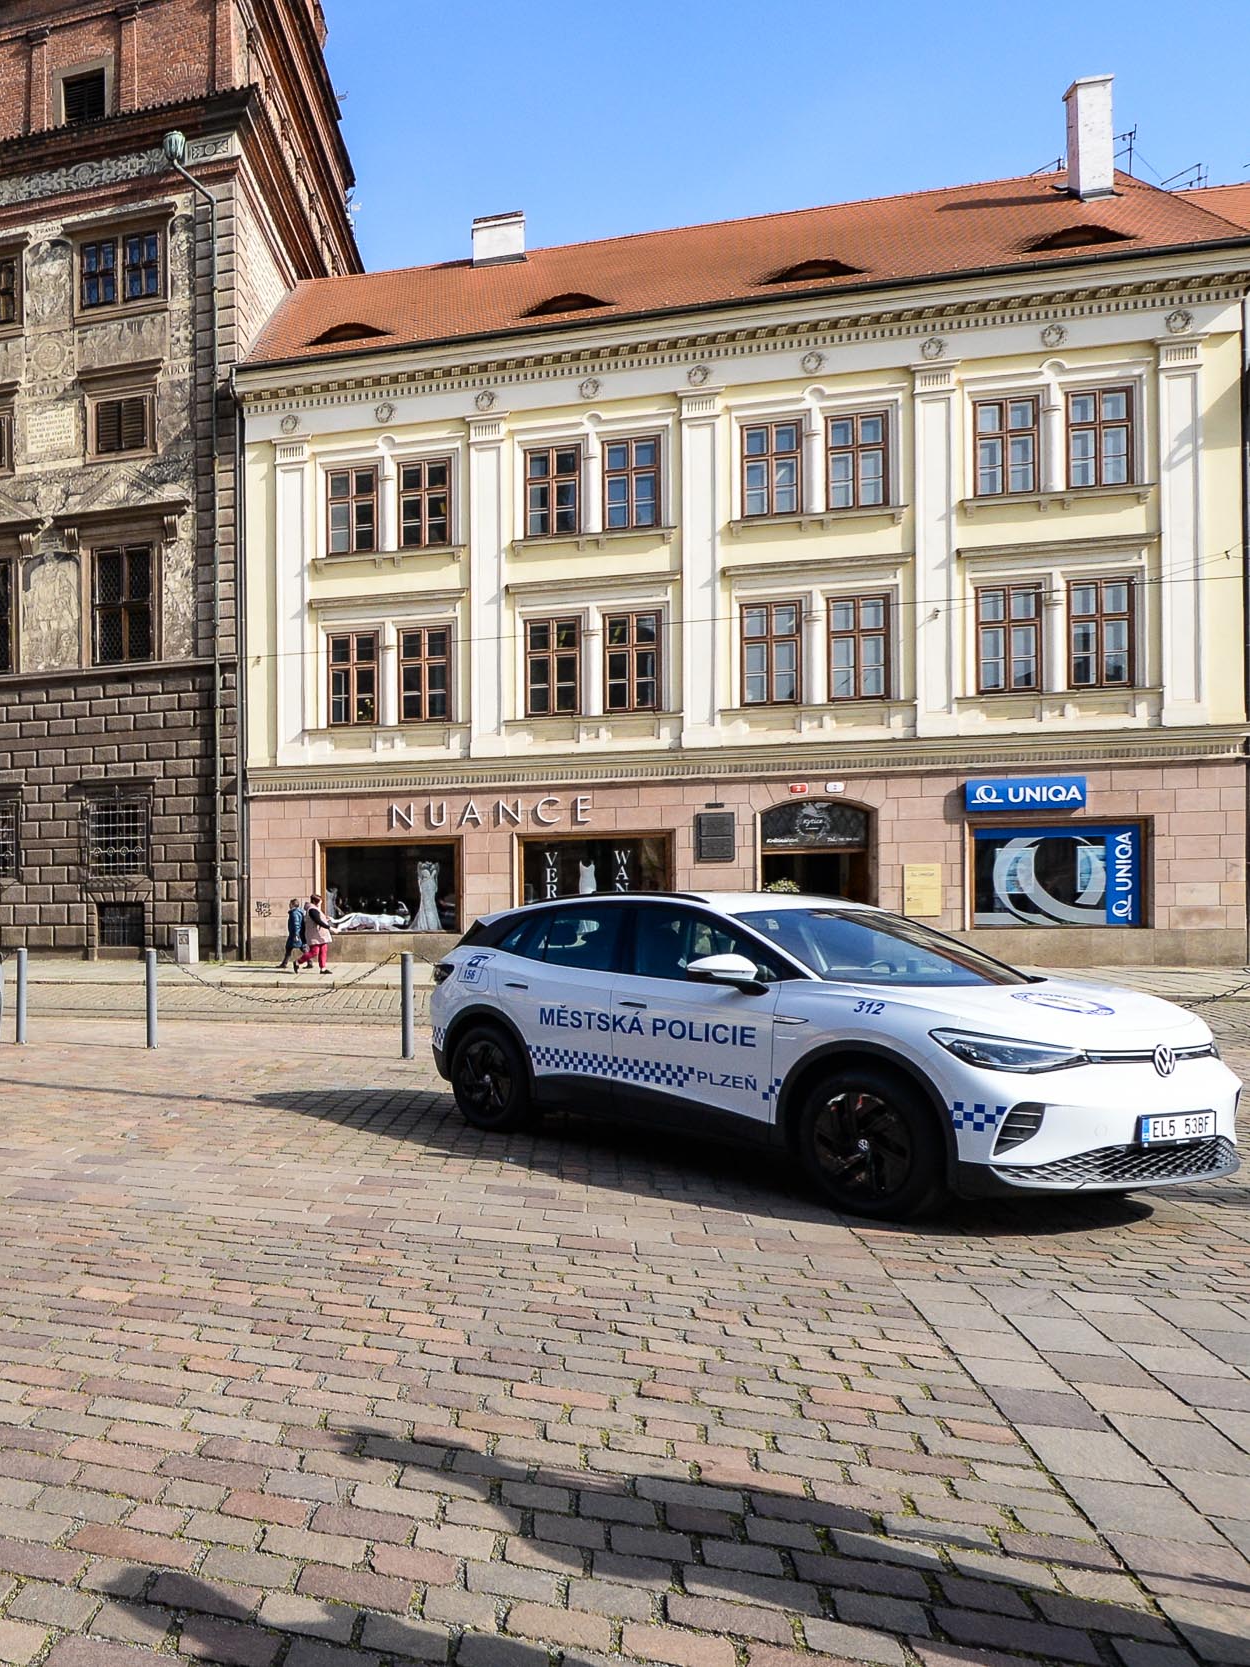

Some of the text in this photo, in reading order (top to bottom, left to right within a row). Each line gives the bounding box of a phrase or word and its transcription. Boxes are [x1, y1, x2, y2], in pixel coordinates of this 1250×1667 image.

[1007, 785, 1083, 803] UNIQA
[391, 796, 592, 828] NUANCE
[1115, 832, 1133, 891] UNIQA
[853, 1000, 886, 1015] 312
[539, 1005, 757, 1048] MĚSTSKÁ POLICIE
[696, 1070, 758, 1091] PLZEŇ
[1152, 1115, 1211, 1138] EL5 53BF
